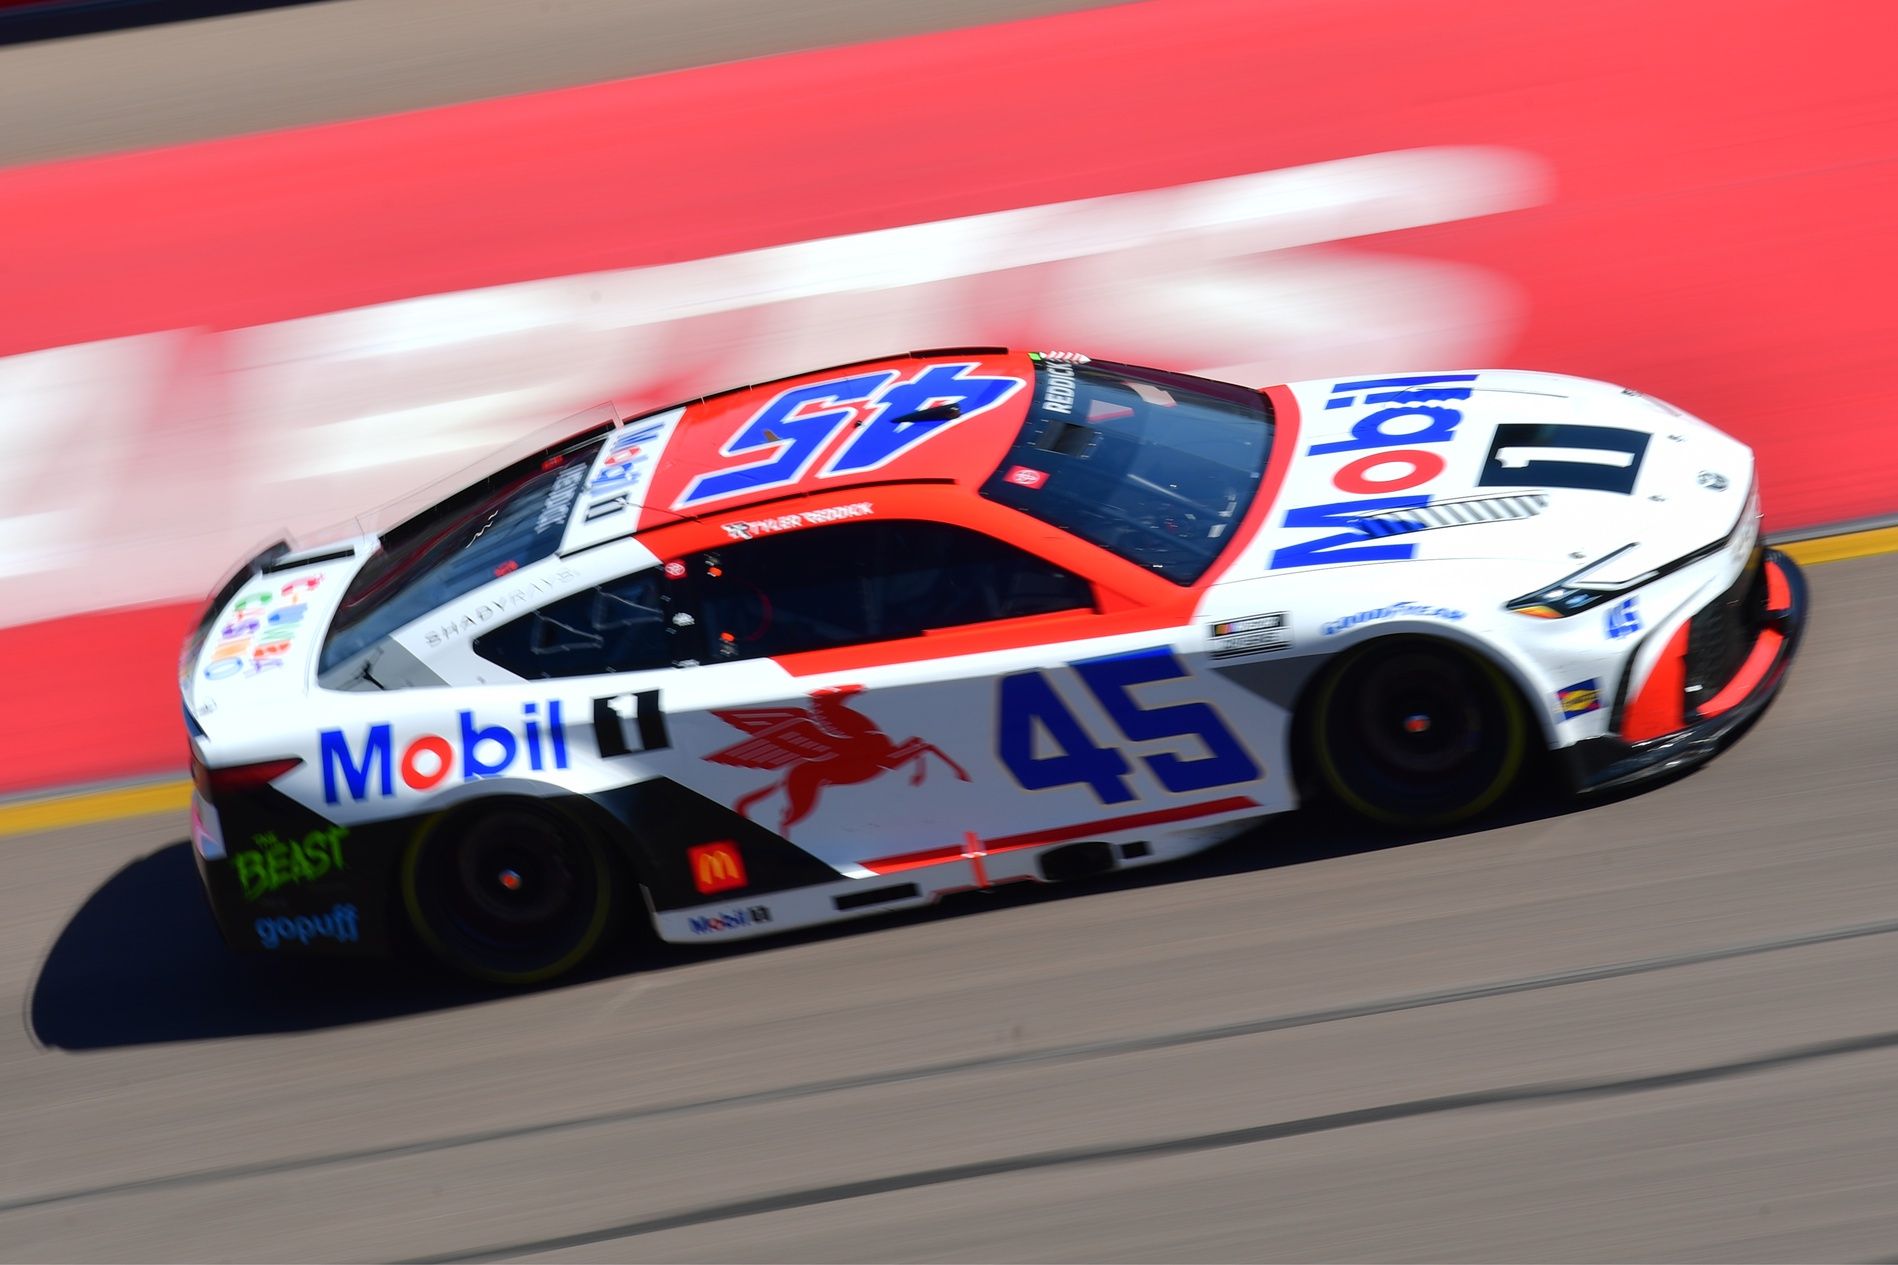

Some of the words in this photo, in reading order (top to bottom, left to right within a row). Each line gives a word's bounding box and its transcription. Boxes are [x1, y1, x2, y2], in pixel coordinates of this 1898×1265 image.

[671, 362, 1026, 511] 45
[1042, 360, 1076, 415] REDDICK
[1268, 374, 1479, 570] Mobil
[316, 699, 569, 806] Mobil
[997, 645, 1265, 806] 45
[234, 824, 351, 901] BEAST
[254, 903, 360, 949] gopuff
